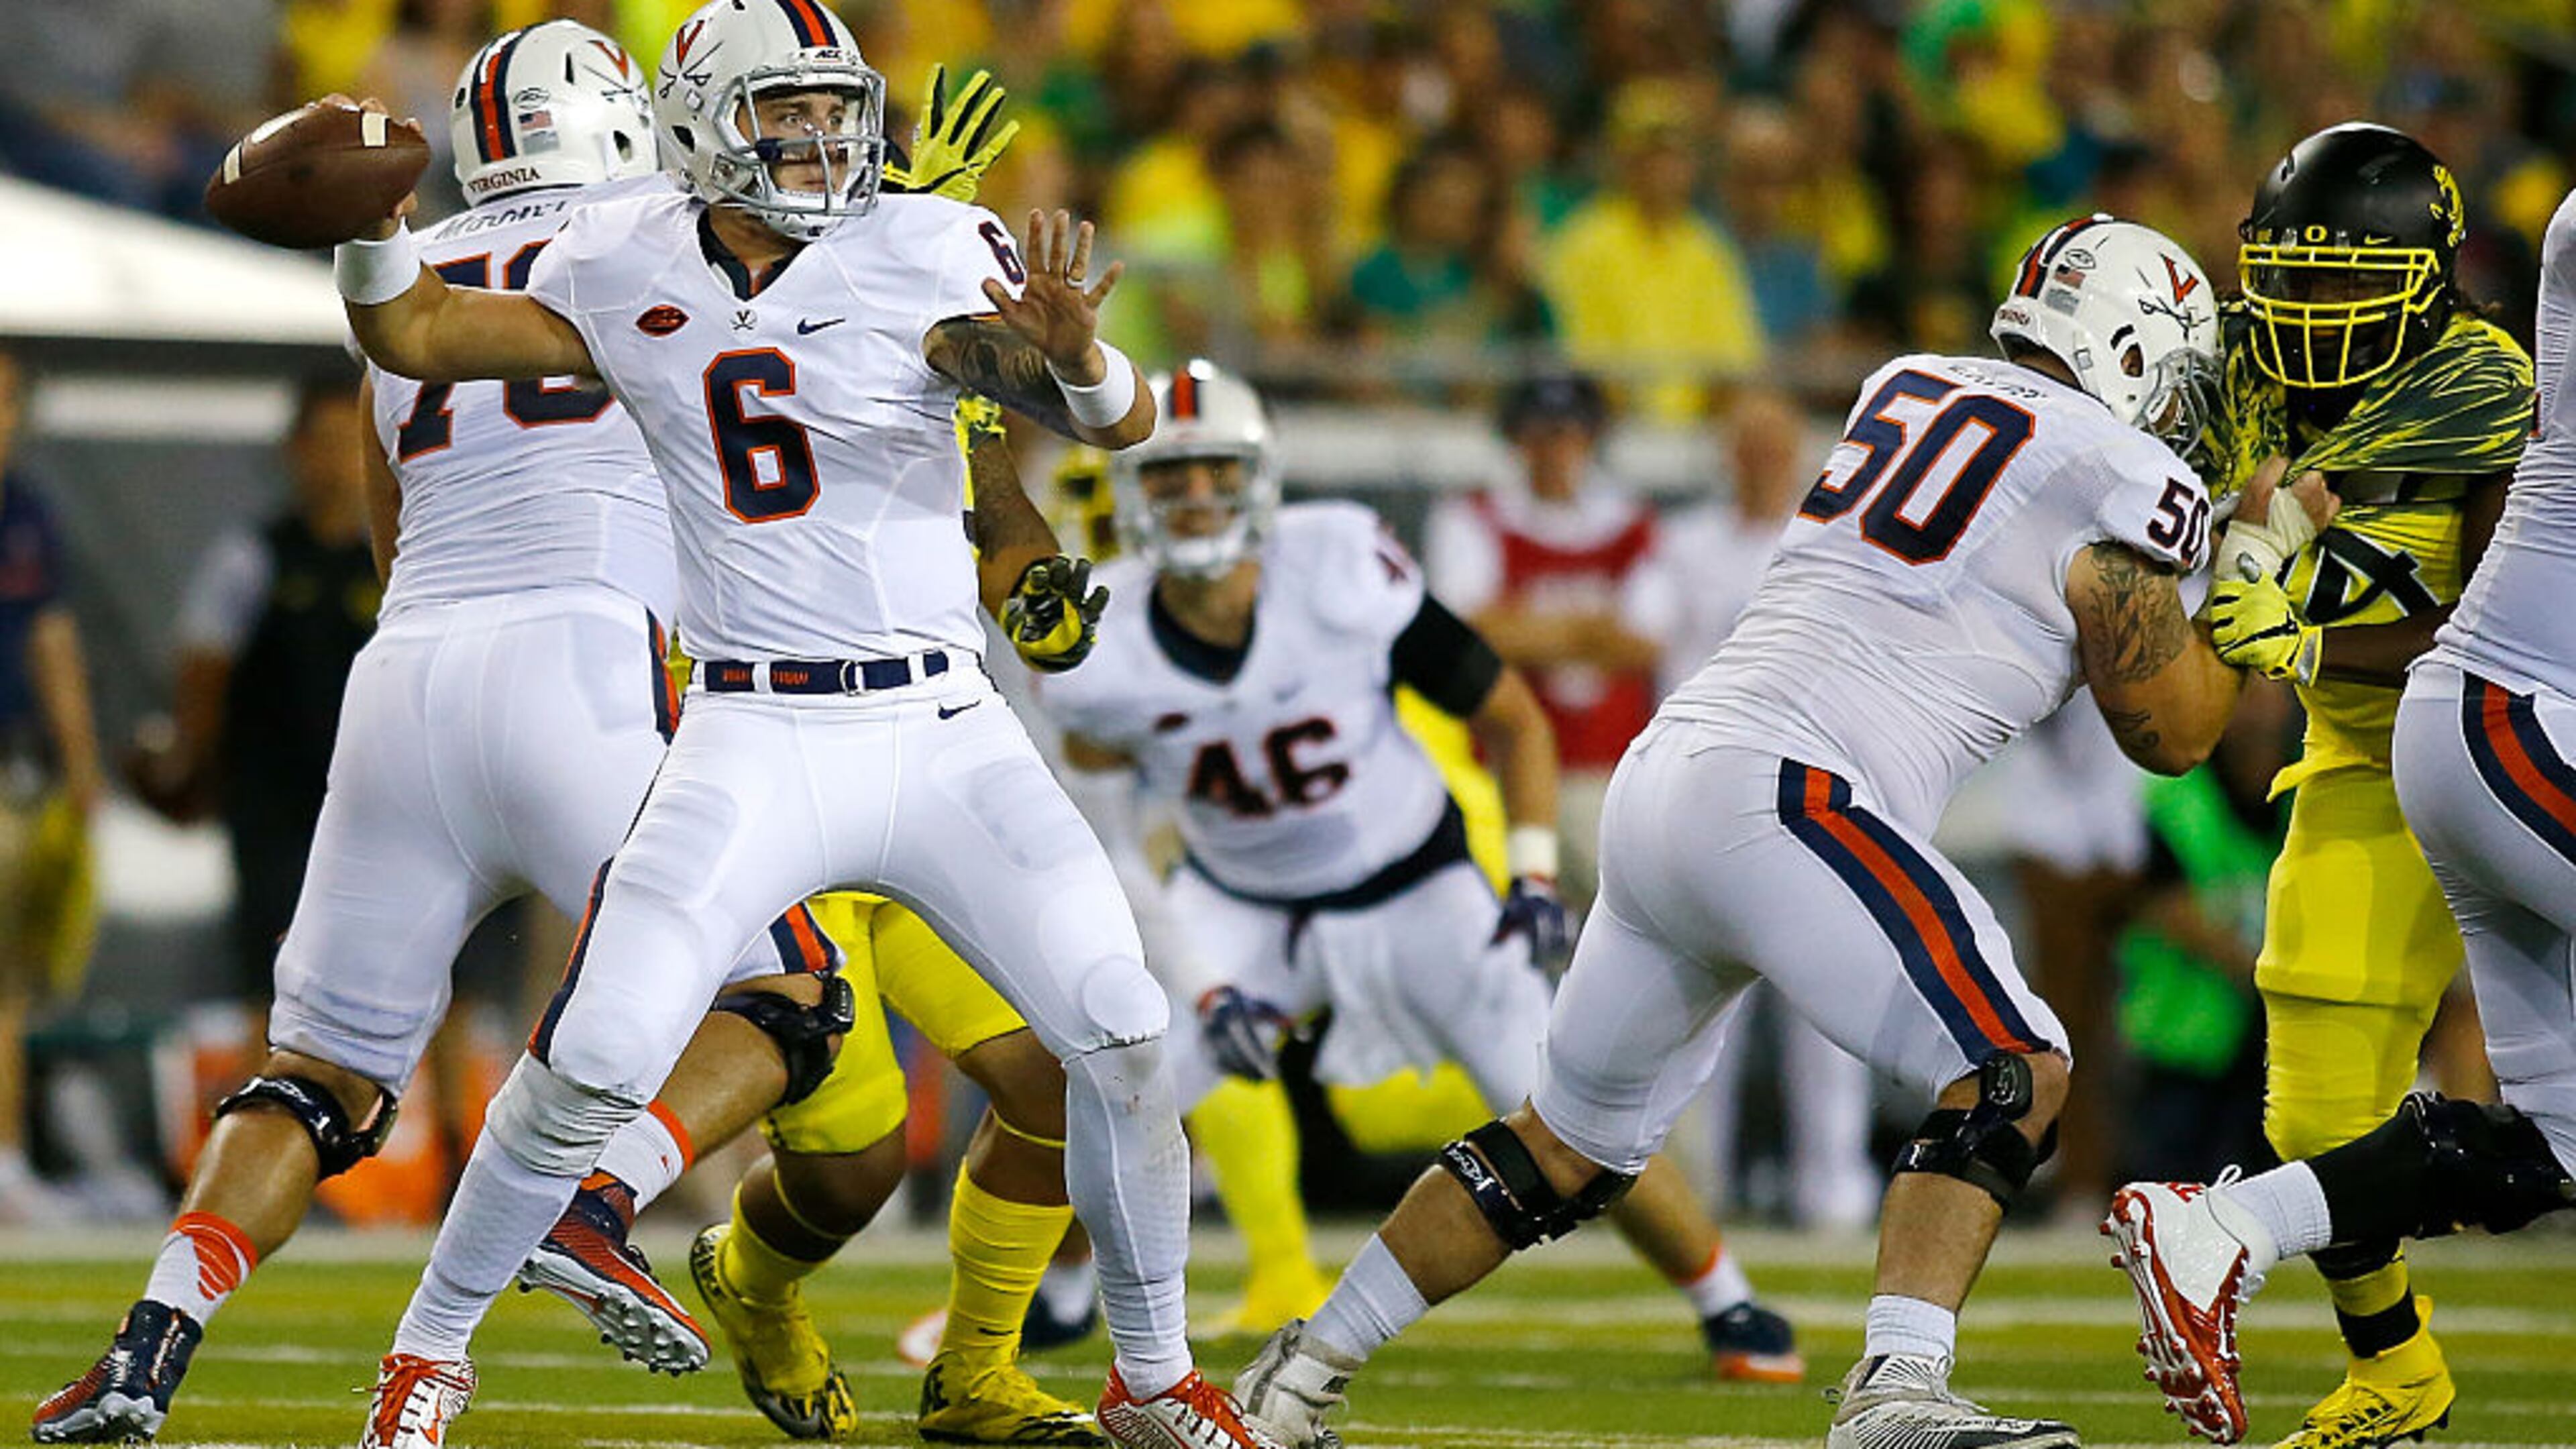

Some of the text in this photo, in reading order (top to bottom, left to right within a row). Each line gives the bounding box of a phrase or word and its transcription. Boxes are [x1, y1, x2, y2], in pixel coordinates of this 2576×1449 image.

[468, 168, 541, 193] VIRGINIA
[978, 221, 1024, 284] 6
[2304, 225, 2327, 242] O
[704, 347, 820, 524] 6
[1796, 369, 2035, 566] 50
[2147, 477, 2210, 568] 50
[1185, 718, 1351, 818] 46
